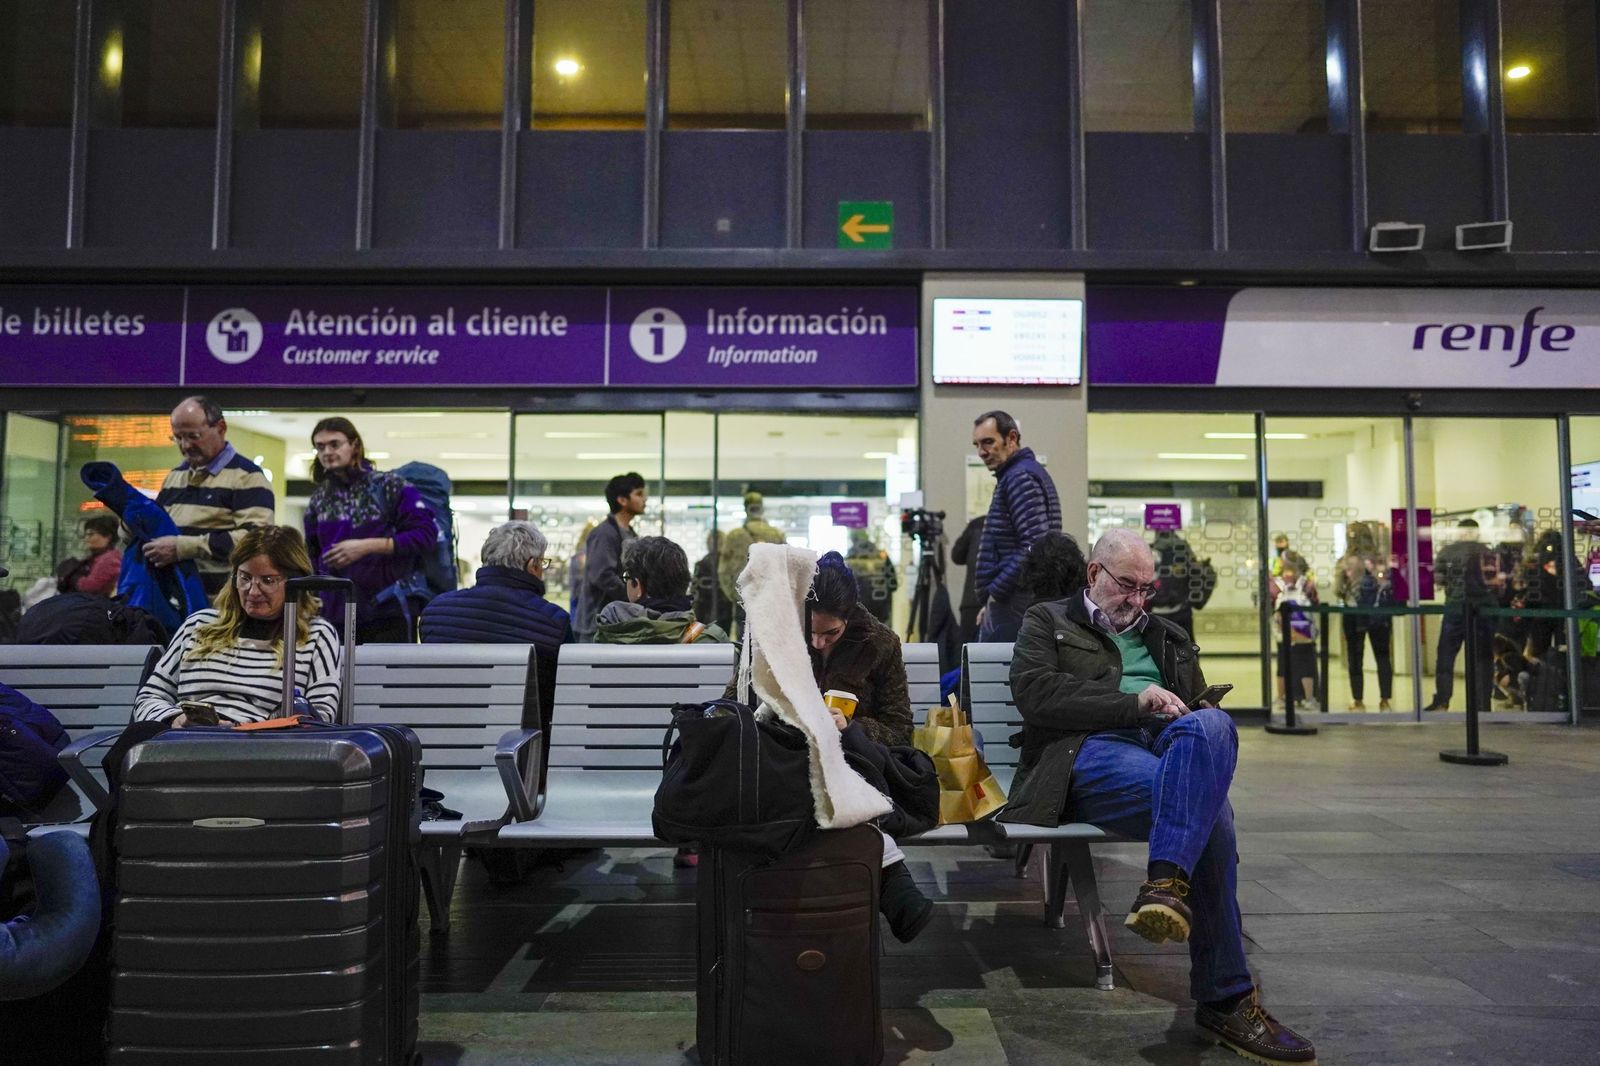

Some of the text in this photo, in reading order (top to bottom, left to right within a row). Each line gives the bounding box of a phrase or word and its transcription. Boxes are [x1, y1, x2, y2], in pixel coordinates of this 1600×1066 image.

[0, 306, 145, 336] e billetes
[284, 307, 568, 337] Atención al cliente
[706, 306, 887, 337] Información
[1412, 306, 1576, 368] renfe
[283, 344, 440, 366] Customer service
[707, 344, 819, 368] Information
